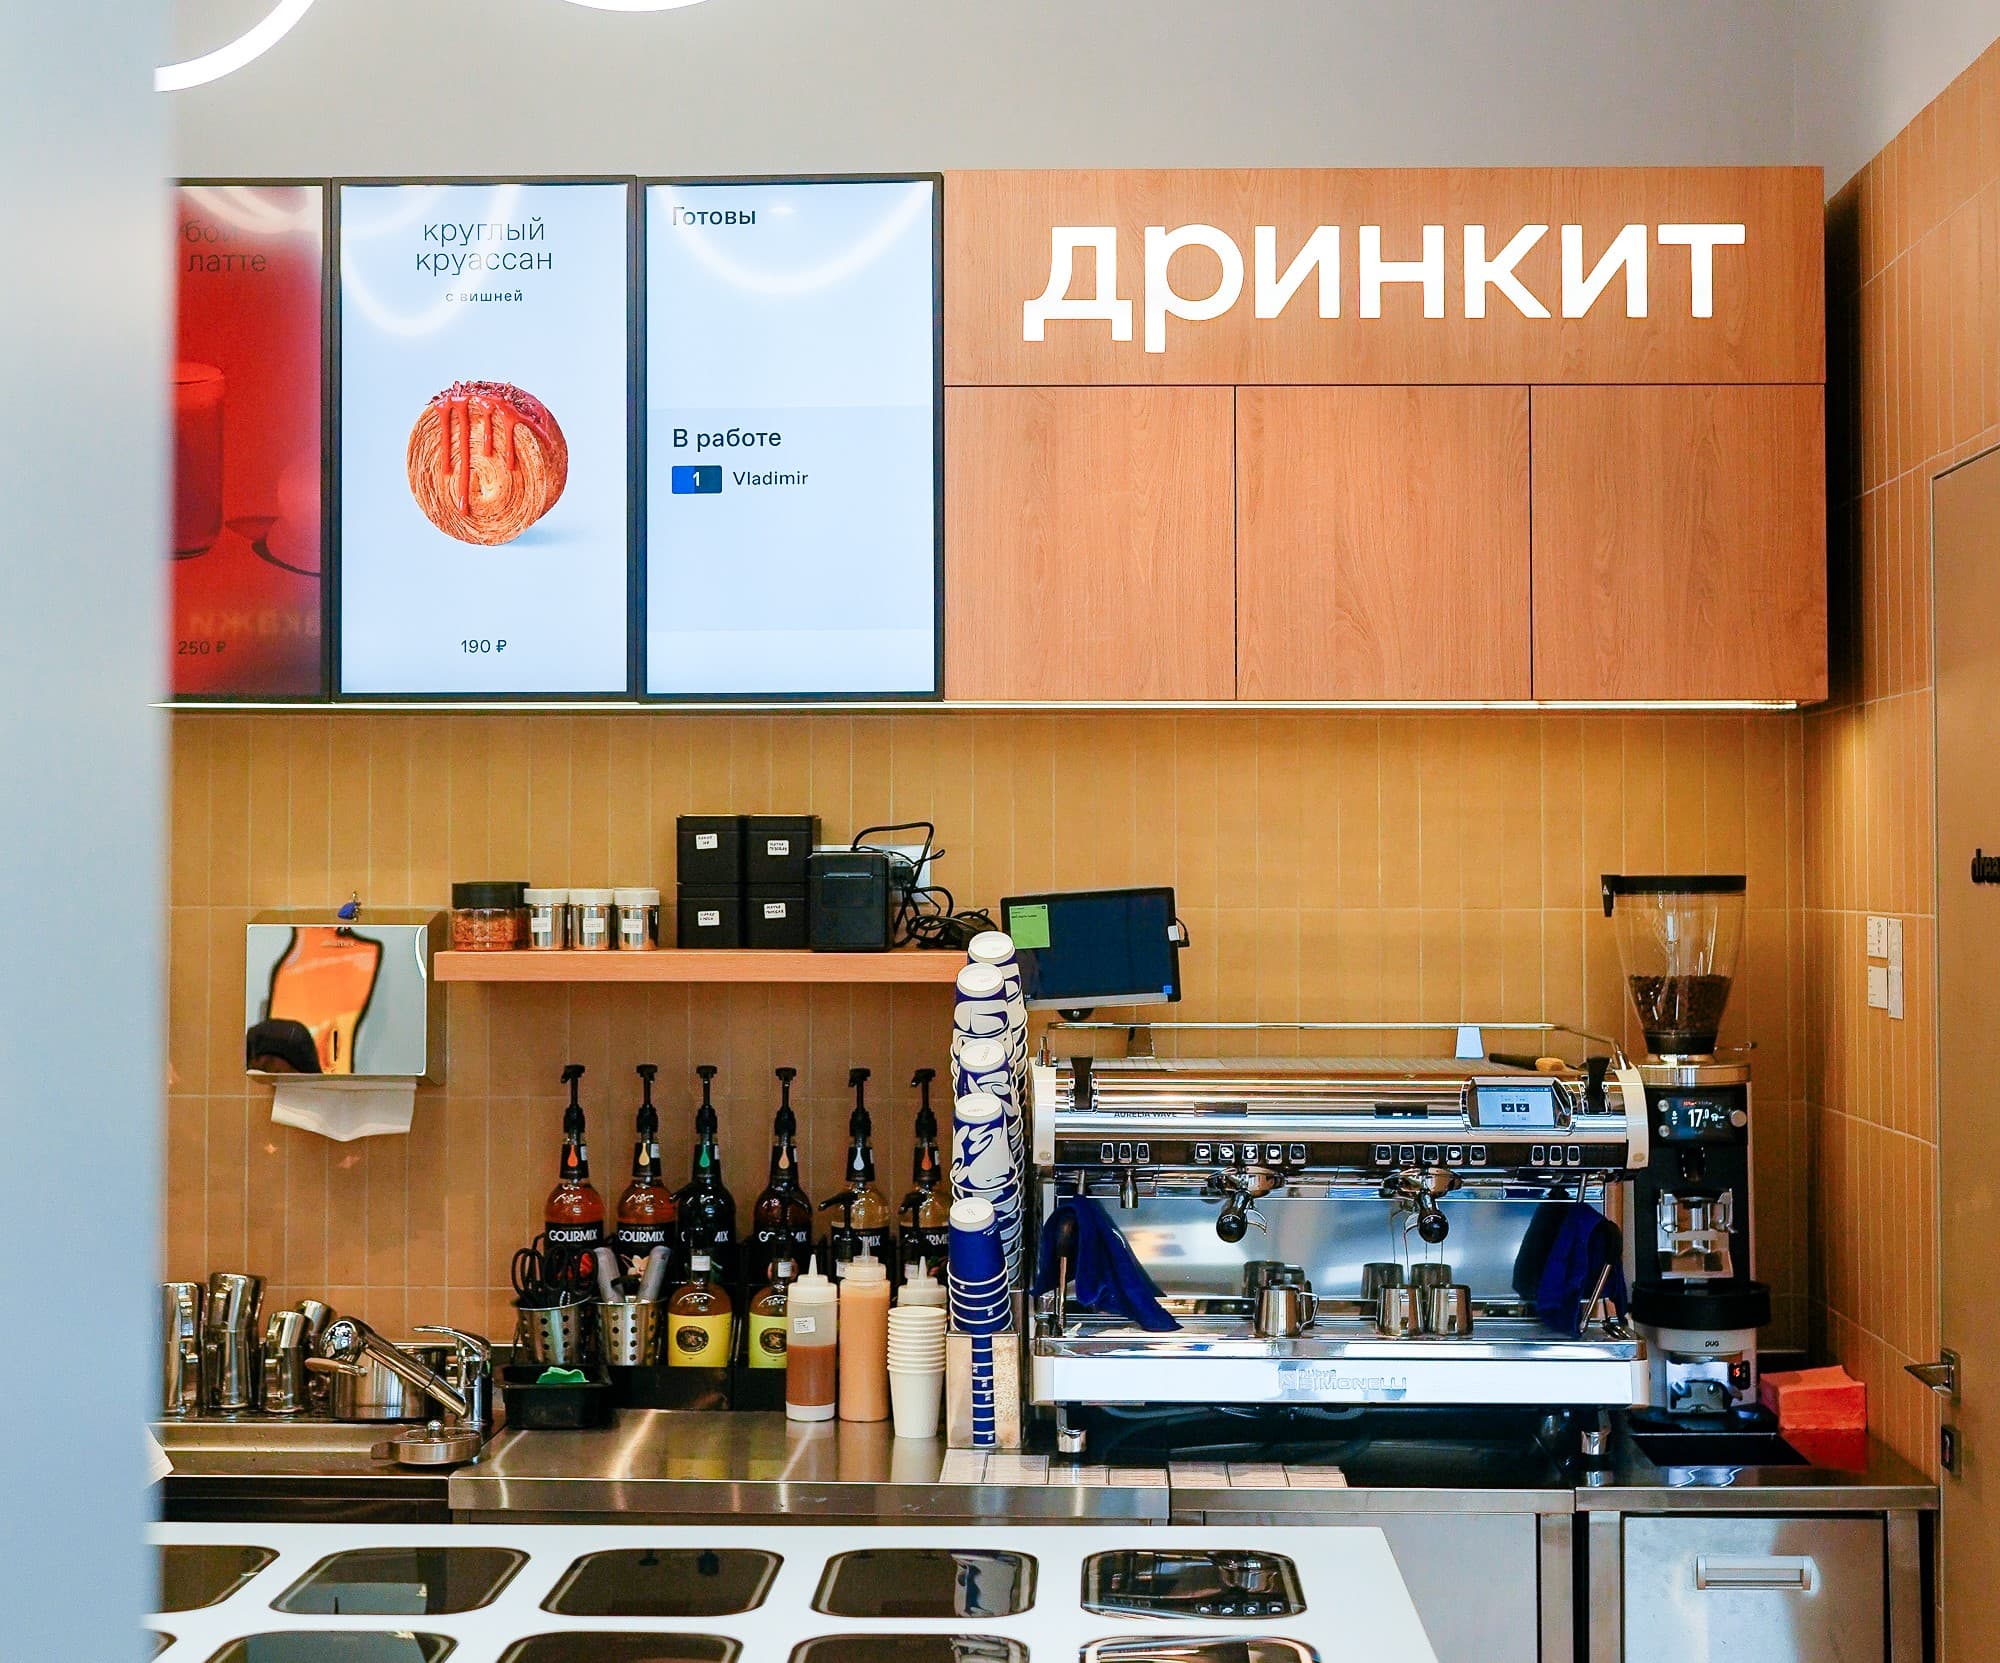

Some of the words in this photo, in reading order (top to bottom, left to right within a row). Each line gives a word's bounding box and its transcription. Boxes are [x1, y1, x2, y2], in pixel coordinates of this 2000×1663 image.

[673, 206, 756, 225] Готовы
[424, 216, 545, 248] круглый
[187, 253, 267, 273] латте
[416, 251, 553, 276] круассан
[445, 292, 454, 302] с
[460, 289, 524, 302] вишней
[1023, 224, 1746, 353] дринкит
[672, 428, 688, 448] В
[696, 427, 782, 453] работе
[692, 471, 701, 487] 1
[733, 470, 809, 487] Vladimir
[177, 640, 210, 655] 250
[460, 638, 491, 654] 190
[549, 1229, 598, 1242] GOURMIX
[618, 1230, 665, 1242] GOURMIX
